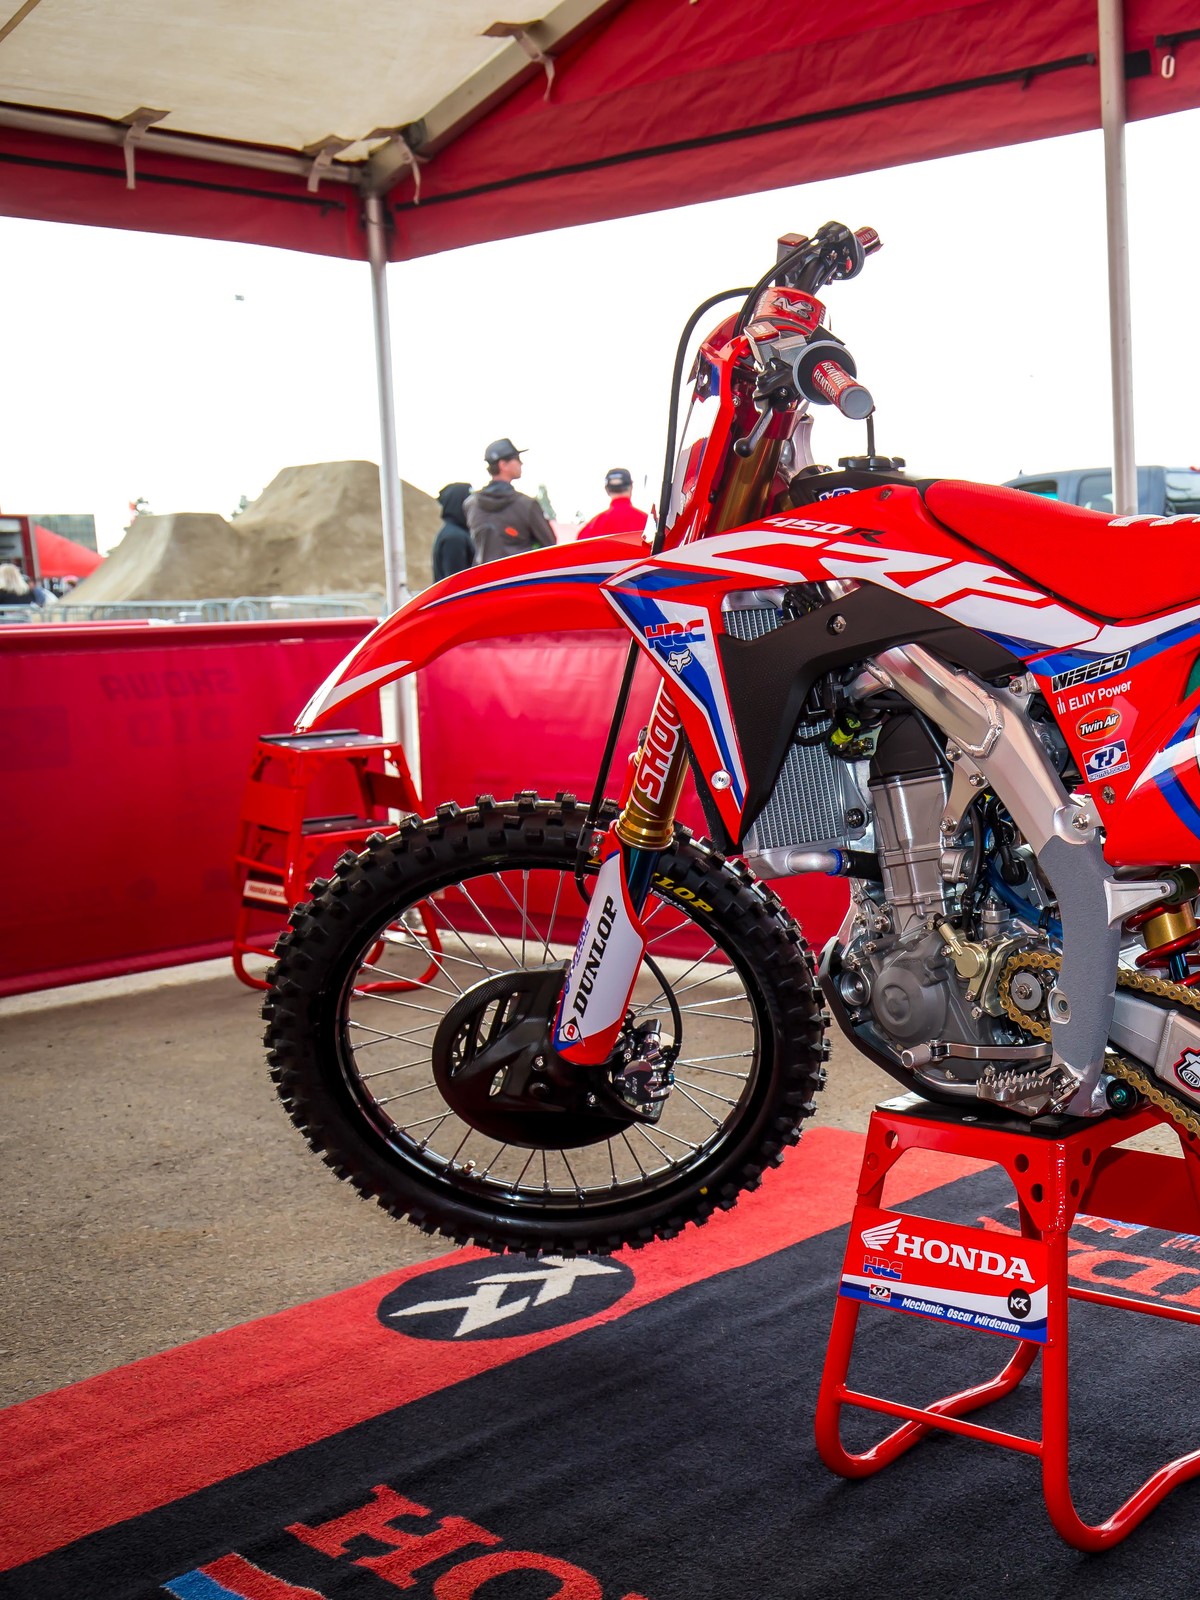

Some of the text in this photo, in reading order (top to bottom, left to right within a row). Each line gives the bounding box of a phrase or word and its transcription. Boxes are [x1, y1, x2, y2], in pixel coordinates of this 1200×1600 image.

[762, 517, 886, 544] 450R
[644, 618, 706, 649] HRC
[1098, 680, 1132, 700] Power
[1080, 713, 1119, 736] Twin Air
[572, 895, 617, 1018] DUNLOP
[863, 1254, 903, 1280] HRC
[894, 1233, 1036, 1284] HONDA
[902, 1297, 945, 1316] Mechanic:
[947, 1308, 974, 1323] Oscar
[975, 1315, 1021, 1334] Wirdeman
